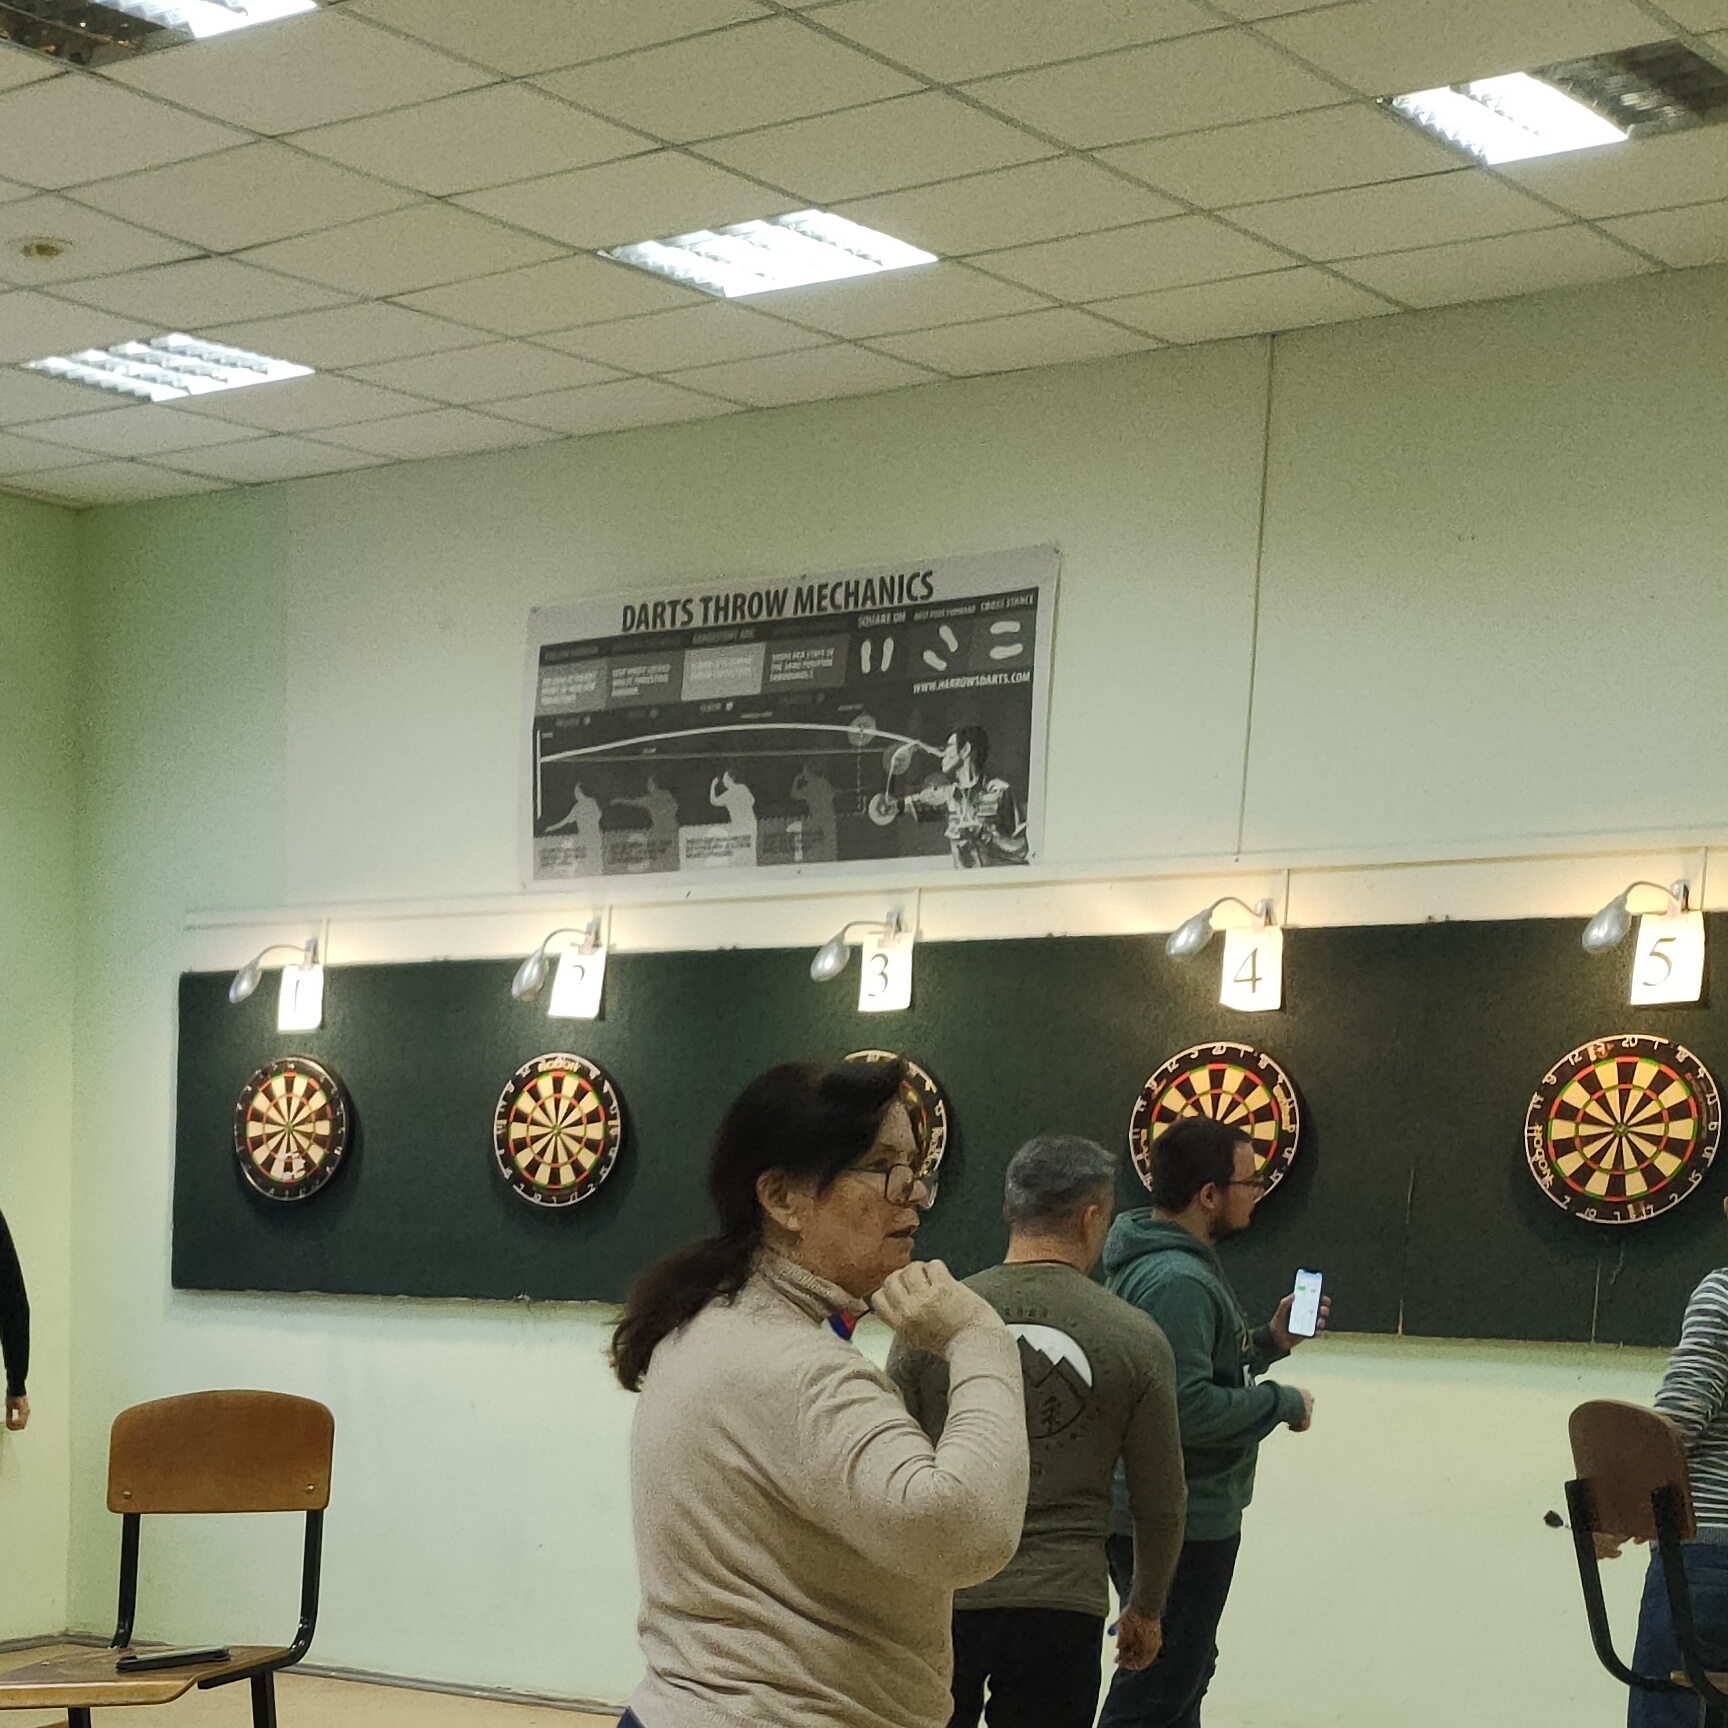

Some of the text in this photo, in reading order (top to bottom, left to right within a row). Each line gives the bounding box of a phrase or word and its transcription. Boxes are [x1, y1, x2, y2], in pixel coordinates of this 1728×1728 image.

[621, 570, 934, 633] DARTS THROW MECHANICS
[858, 611, 906, 628] SQUARE ON
[868, 953, 889, 997] 3
[1233, 947, 1263, 994] 4
[1642, 937, 1676, 987] 5
[293, 979, 301, 1014] 1
[1621, 1037, 1639, 1048] 20
